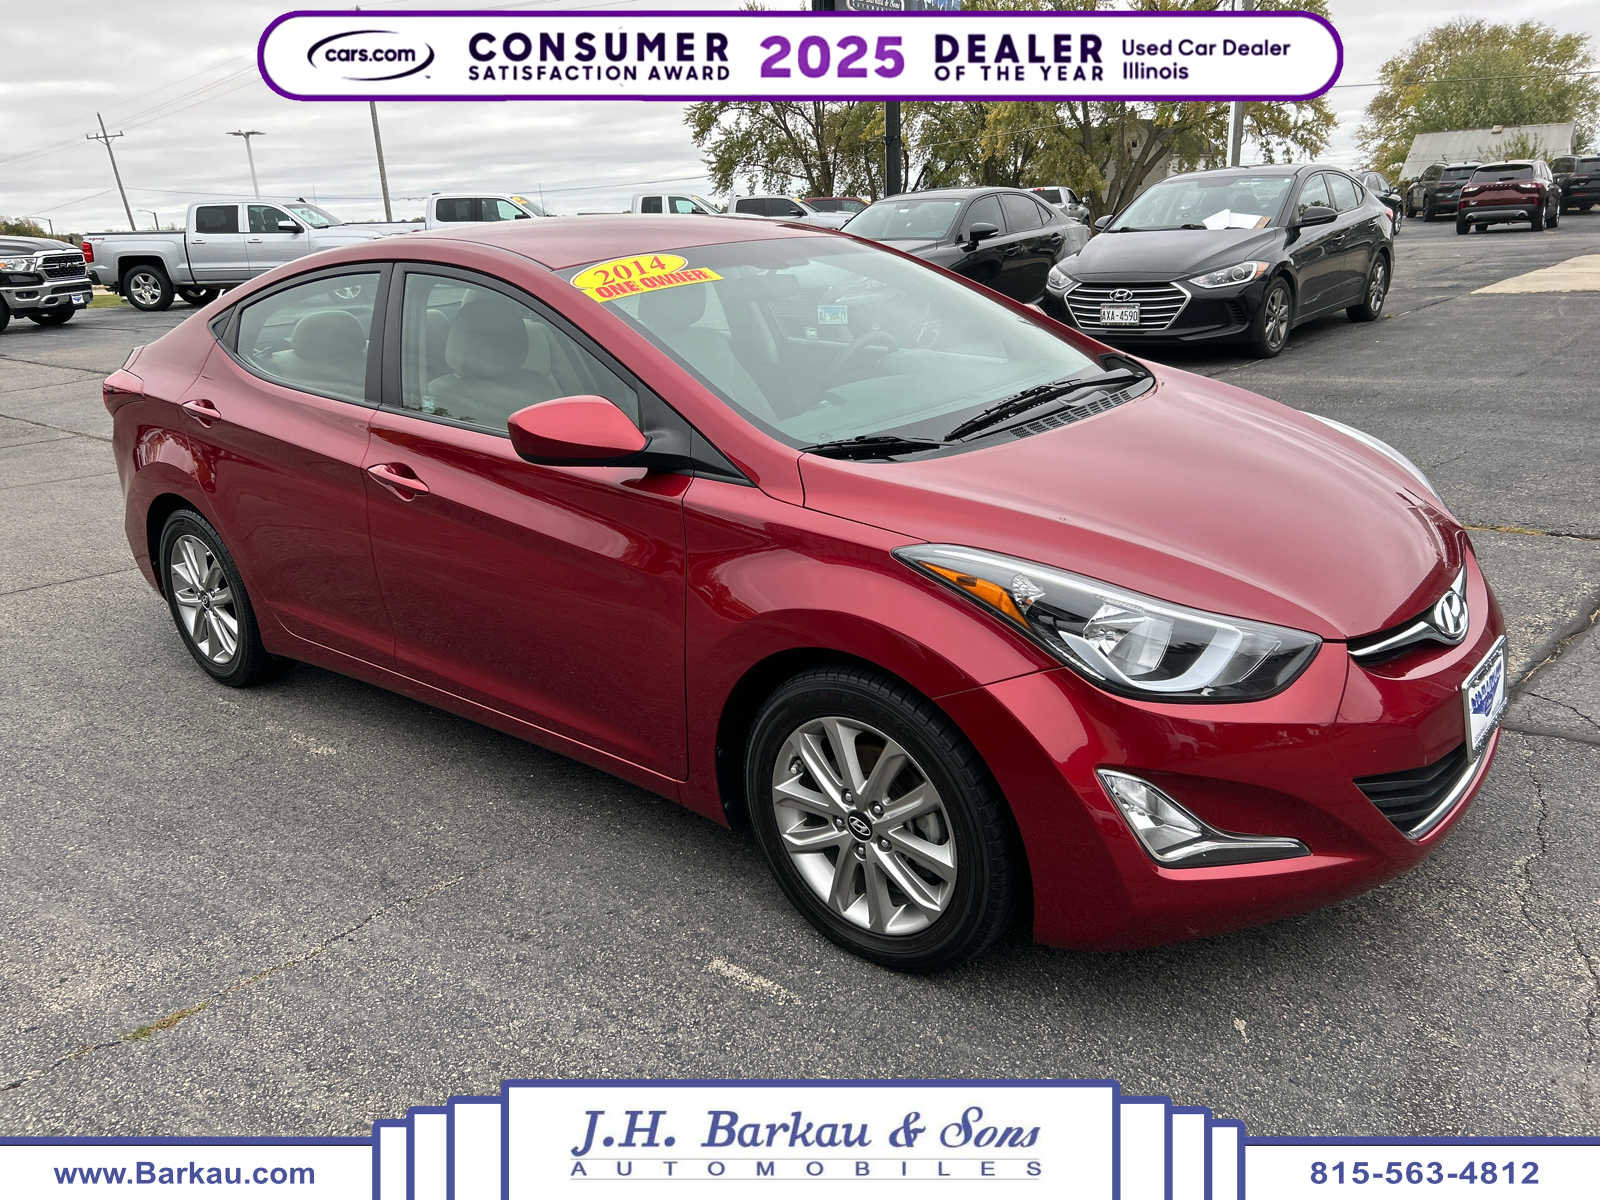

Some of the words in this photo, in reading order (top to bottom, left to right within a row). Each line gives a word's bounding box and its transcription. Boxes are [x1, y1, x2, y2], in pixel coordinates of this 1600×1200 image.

[593, 255, 666, 286] 2014
[595, 280, 642, 298] ONE
[639, 269, 709, 289] OWNER
[1101, 310, 1138, 321] AXA-4590
